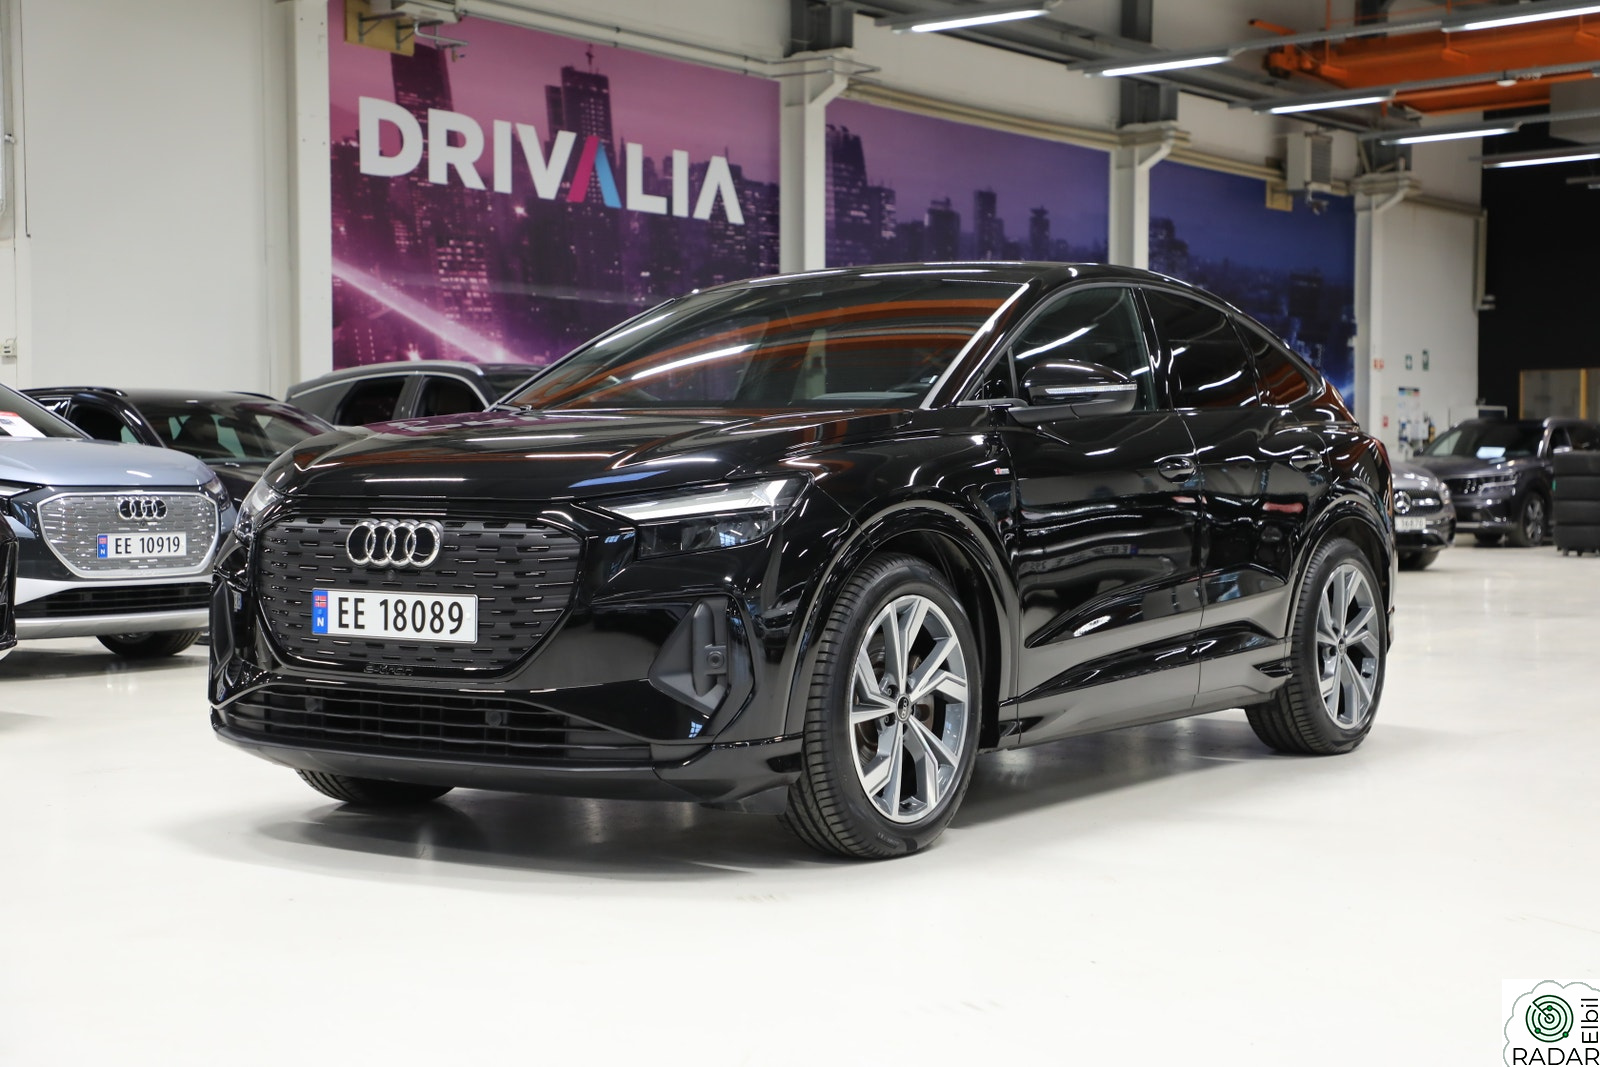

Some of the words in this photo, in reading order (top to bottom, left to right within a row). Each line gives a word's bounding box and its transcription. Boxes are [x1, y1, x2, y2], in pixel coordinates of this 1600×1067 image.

[358, 95, 745, 225] DRIVALIA
[115, 537, 132, 554] EE
[139, 535, 181, 554] 10919
[316, 617, 325, 627] N
[338, 597, 366, 630] EE
[379, 598, 464, 634] 18089
